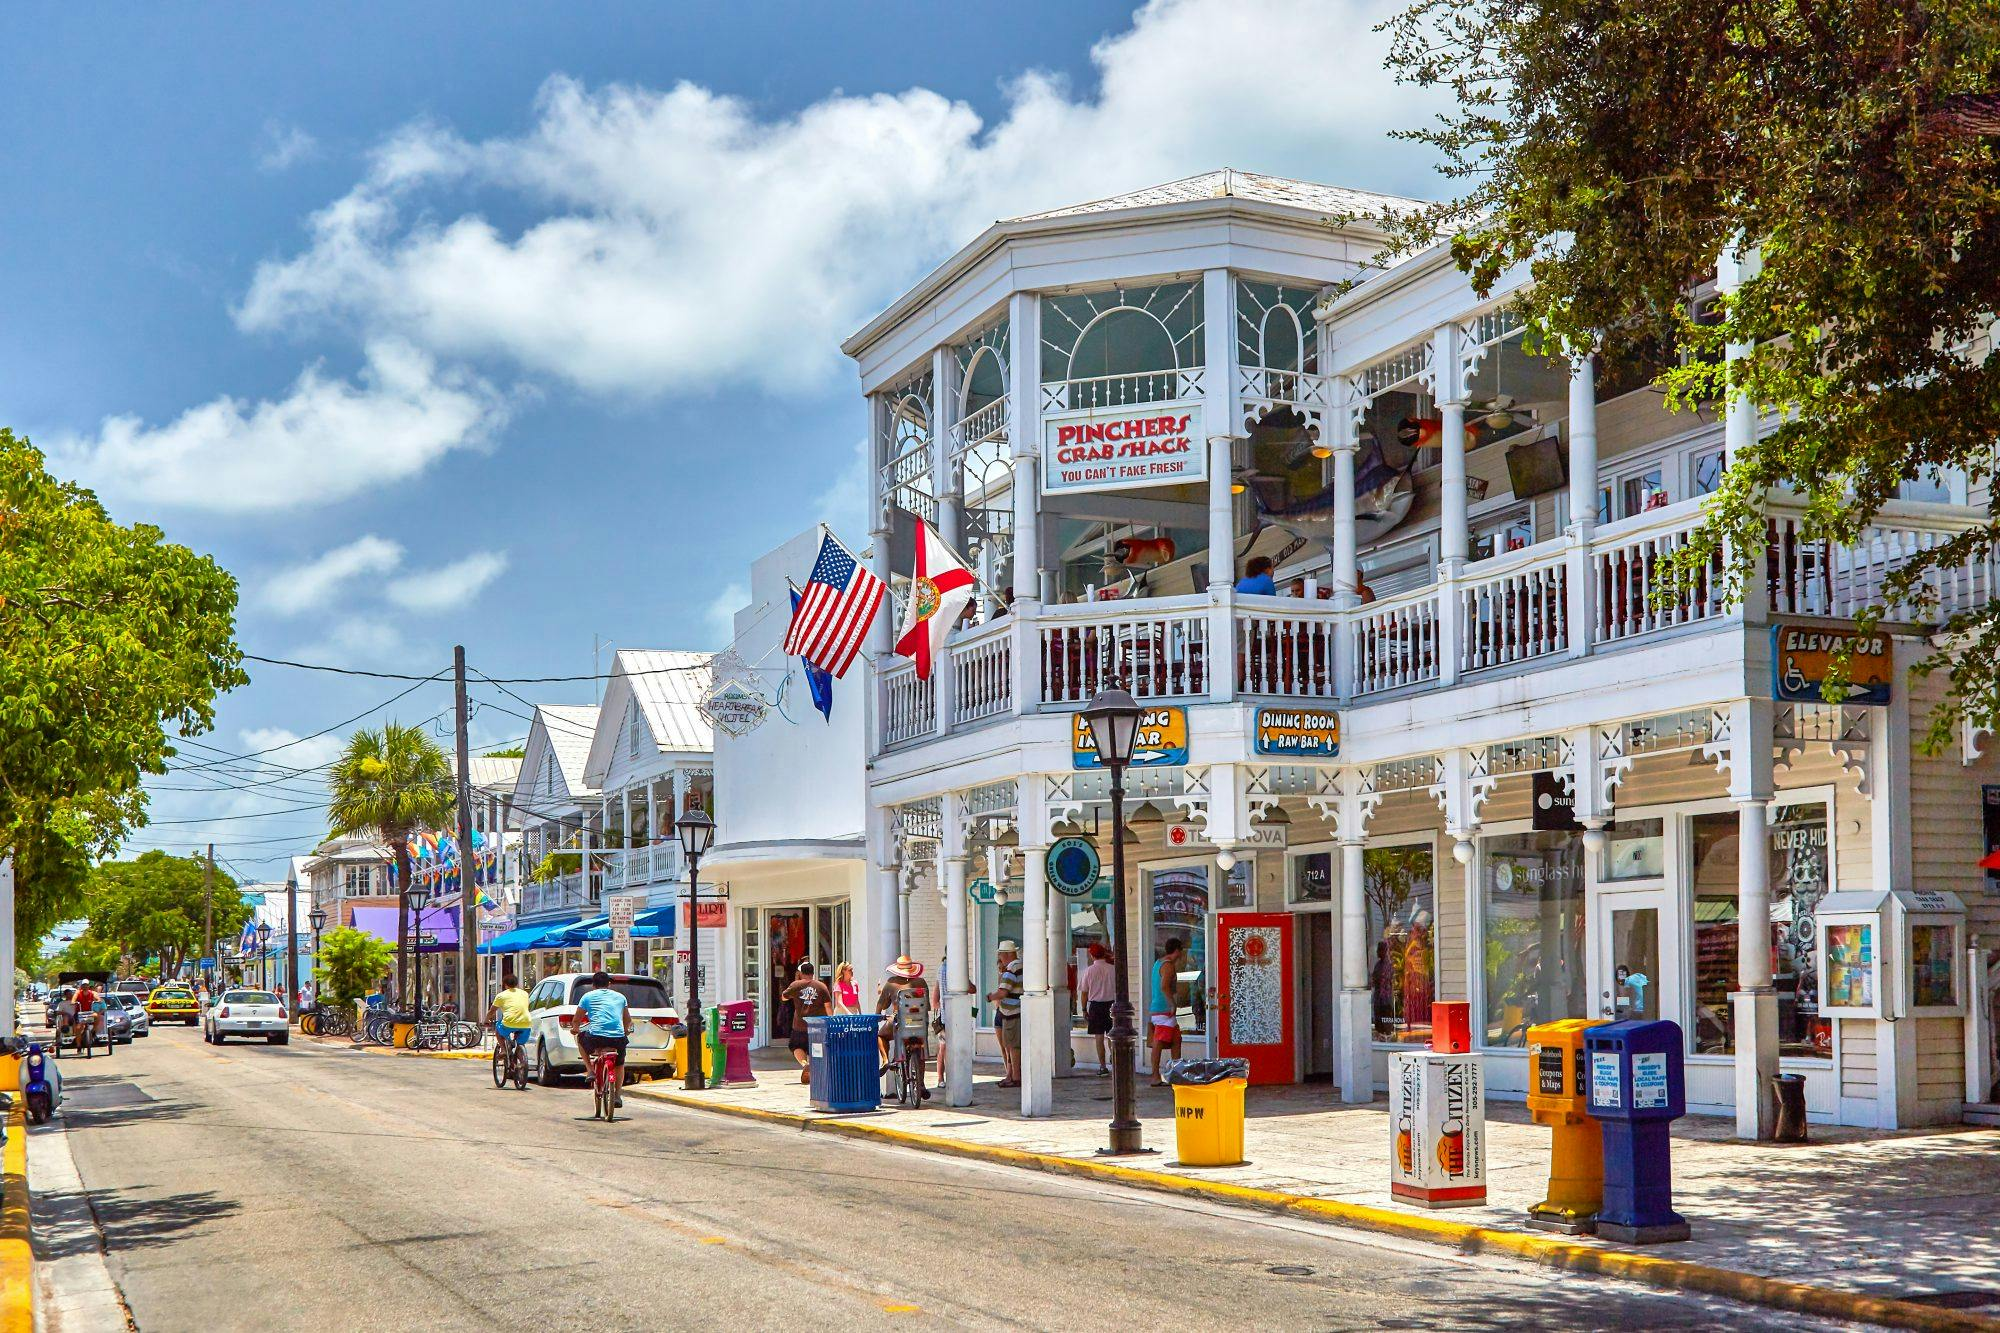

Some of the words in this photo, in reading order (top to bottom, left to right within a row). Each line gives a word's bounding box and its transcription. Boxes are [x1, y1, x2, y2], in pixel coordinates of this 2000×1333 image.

[1057, 413, 1192, 447] PINCHERS
[1057, 443, 1115, 464] CRAB
[1117, 436, 1192, 458] SHACK
[1061, 470, 1082, 482] YOU
[1085, 466, 1116, 480] CAN'T
[1120, 465, 1147, 477] FAKE
[1150, 461, 1184, 474] FRESH
[708, 700, 764, 714] HEARTBREAK
[719, 712, 751, 723] HOTEL
[1262, 712, 1301, 729] DINING
[1304, 714, 1335, 730] ROOM
[1278, 734, 1298, 748] RAW
[1300, 735, 1319, 749] BAR
[1773, 829, 1807, 850] NEVER
[1809, 828, 1828, 846] HID
[1306, 870, 1319, 881] 712
[1319, 869, 1326, 880] A
[1516, 862, 1570, 886] sunglass
[698, 904, 725, 915] LIRT
[1539, 1068, 1563, 1079] Coupons
[1541, 1080, 1546, 1088] &
[1546, 1080, 1561, 1090] Maps
[1398, 1062, 1413, 1136] CITIZEN
[1441, 1063, 1464, 1138] CITIZEN
[1402, 1143, 1413, 1179] THE
[1449, 1145, 1464, 1182] THE
